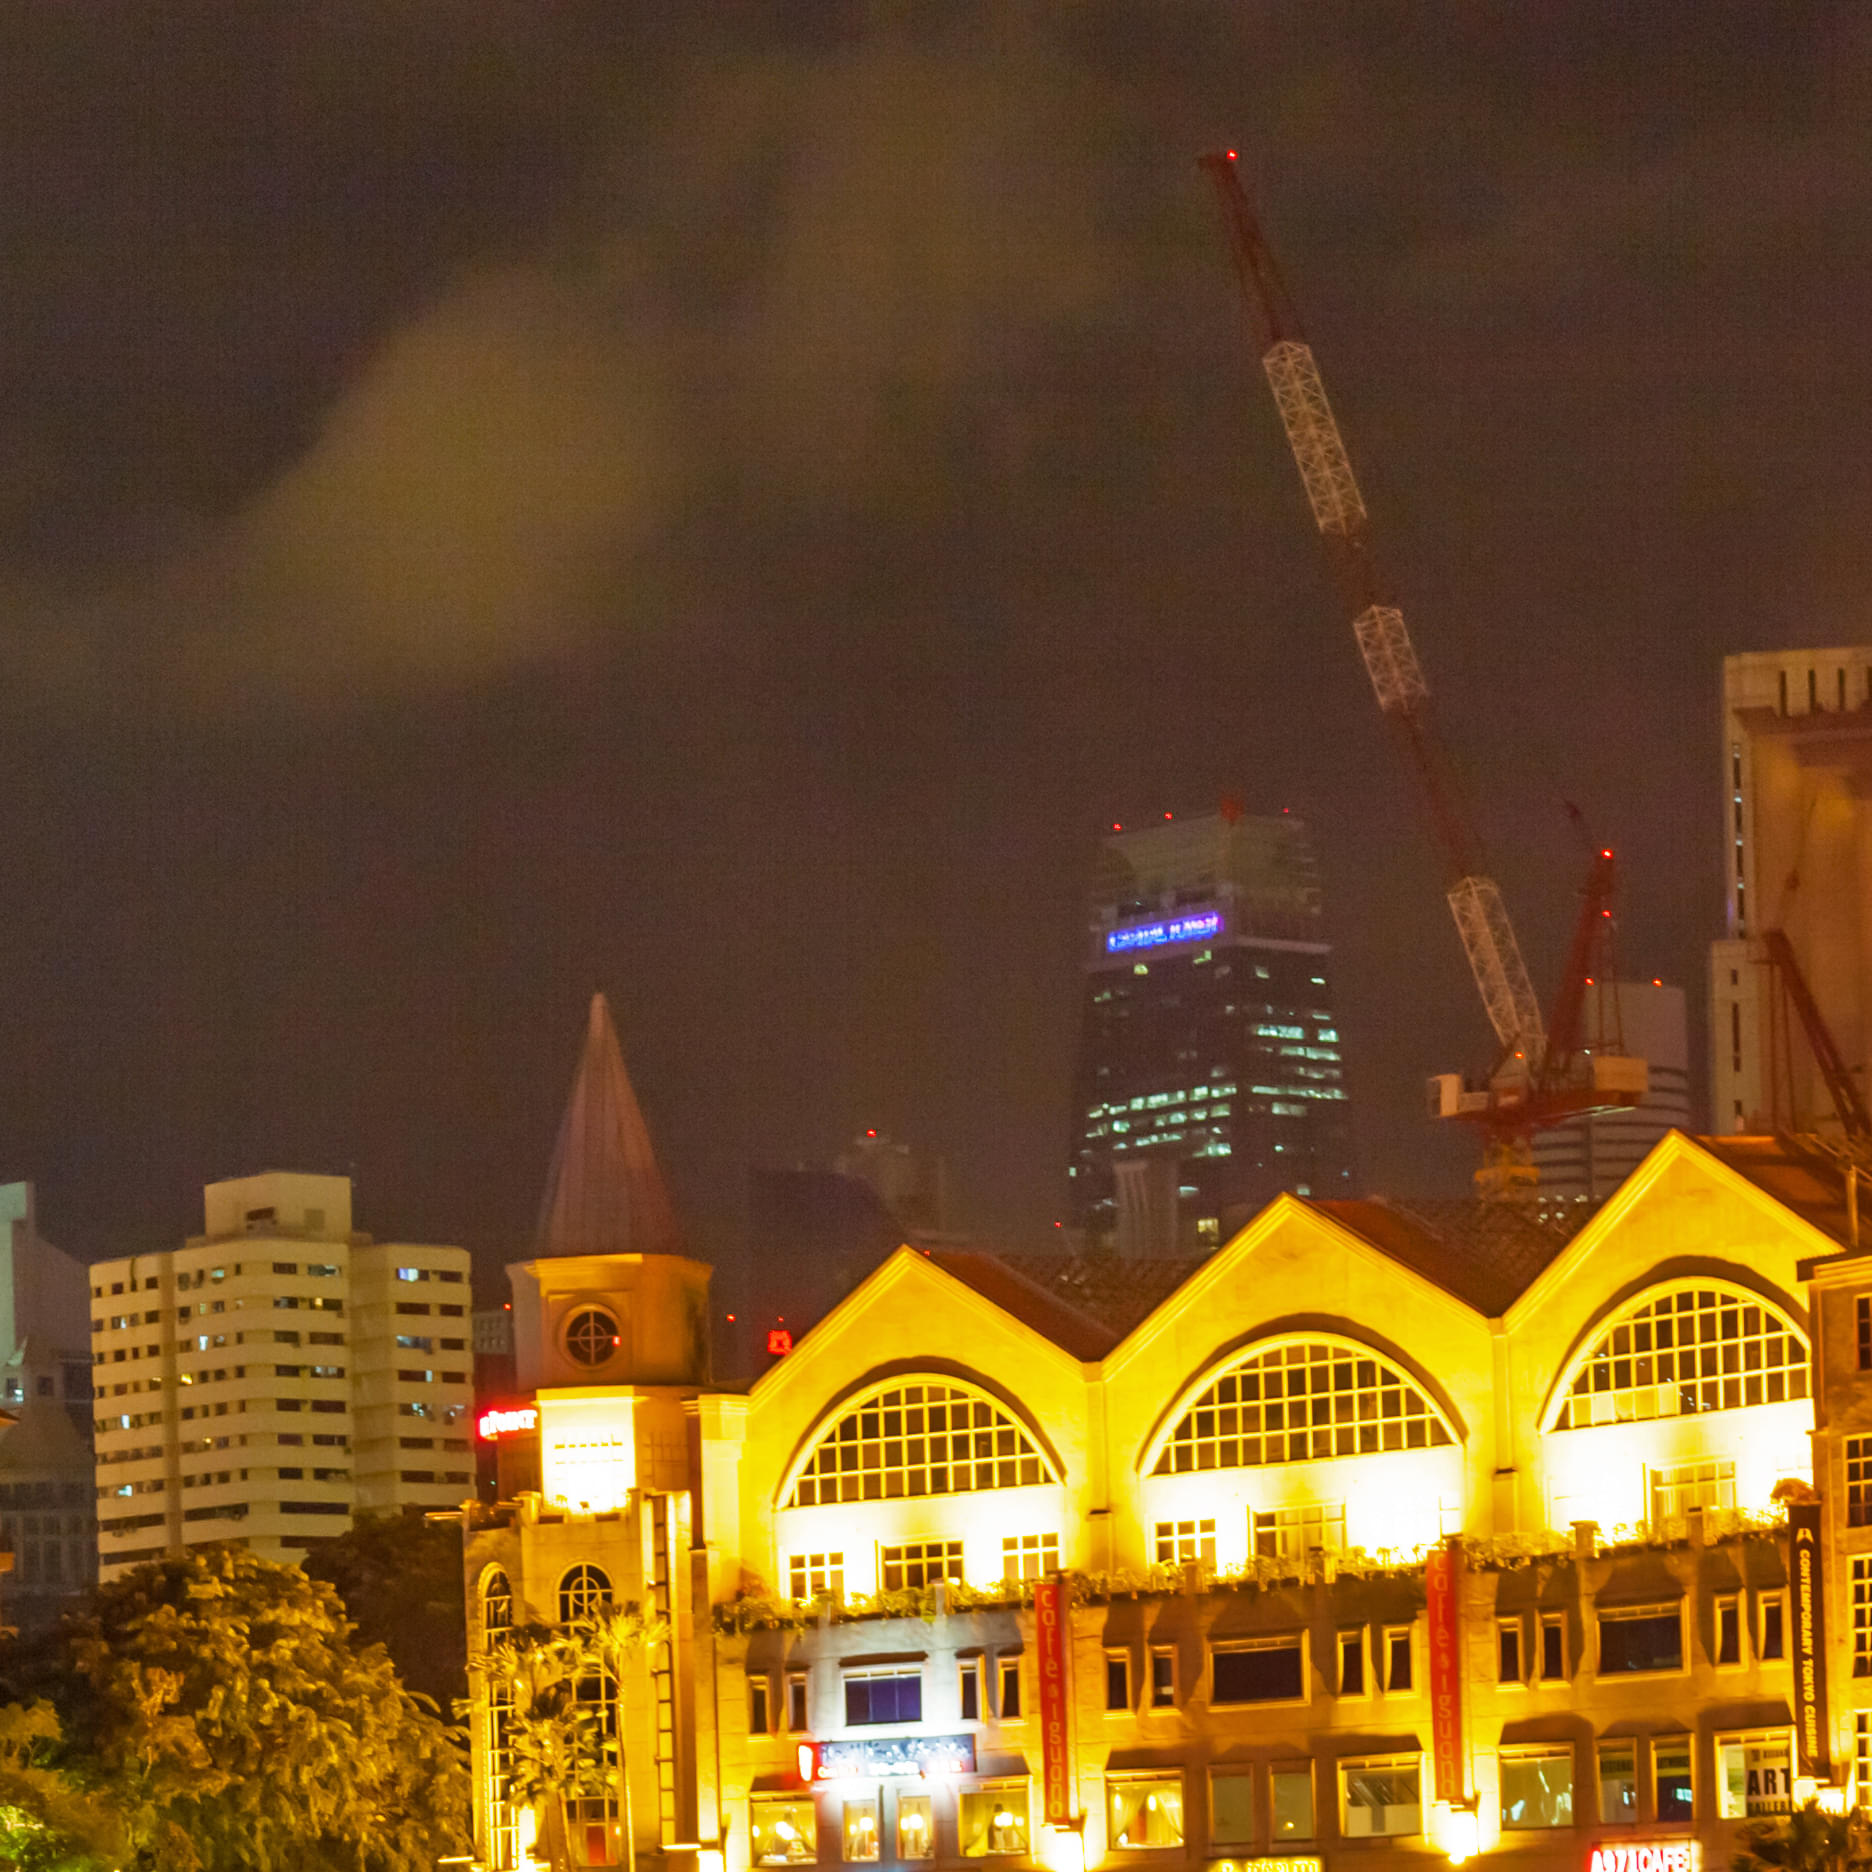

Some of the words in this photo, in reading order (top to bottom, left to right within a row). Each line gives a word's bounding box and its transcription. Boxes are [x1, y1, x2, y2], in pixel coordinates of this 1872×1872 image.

[1800, 1549, 1814, 1655] CONTEMPORARY
[1803, 1658, 1816, 1702] TOKYO
[1804, 1705, 1819, 1758] CUISINE
